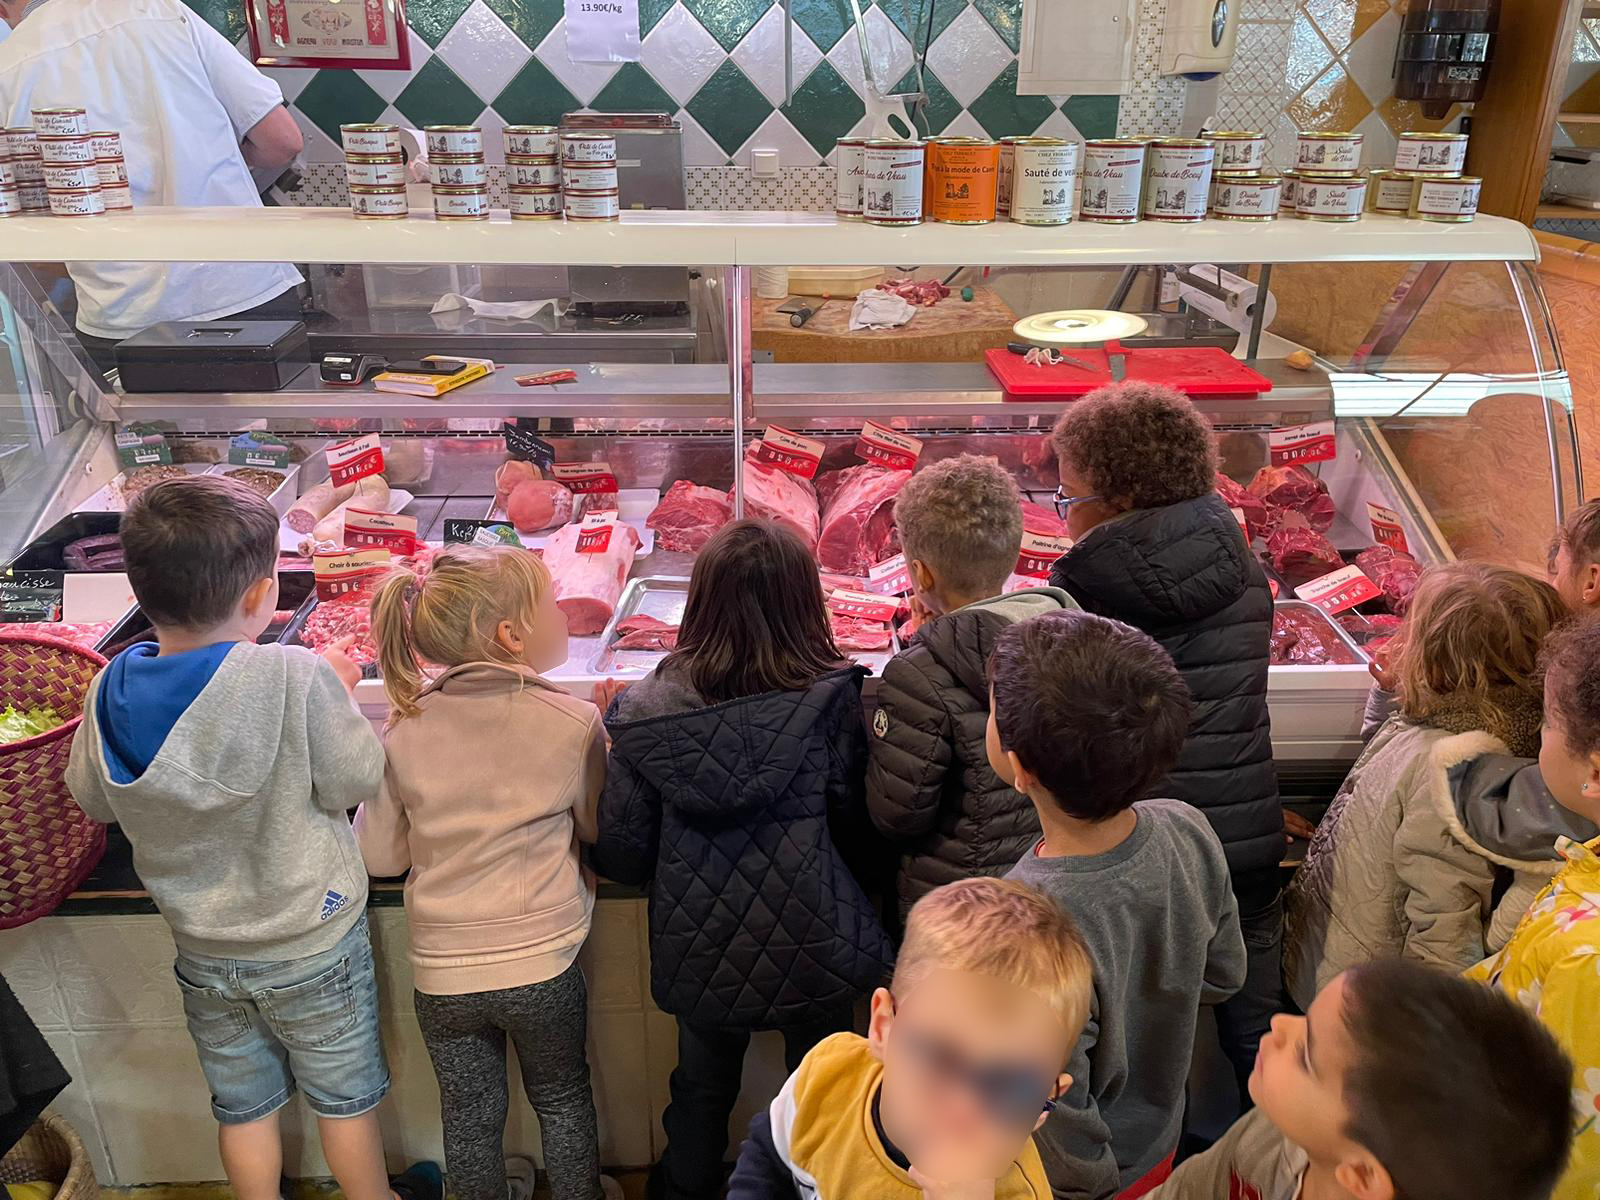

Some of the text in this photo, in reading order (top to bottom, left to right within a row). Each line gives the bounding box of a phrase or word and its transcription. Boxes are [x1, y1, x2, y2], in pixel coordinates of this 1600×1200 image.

[581, 3, 622, 13] 13.90€/kg
[886, 170, 907, 181] Veau
[1024, 167, 1050, 178] Sauté
[1052, 168, 1063, 177] de
[1103, 168, 1123, 179] Veau
[1170, 169, 1180, 178] de
[1032, 539, 1071, 552] Poitrine d'agne
[320, 895, 349, 920] adidas
